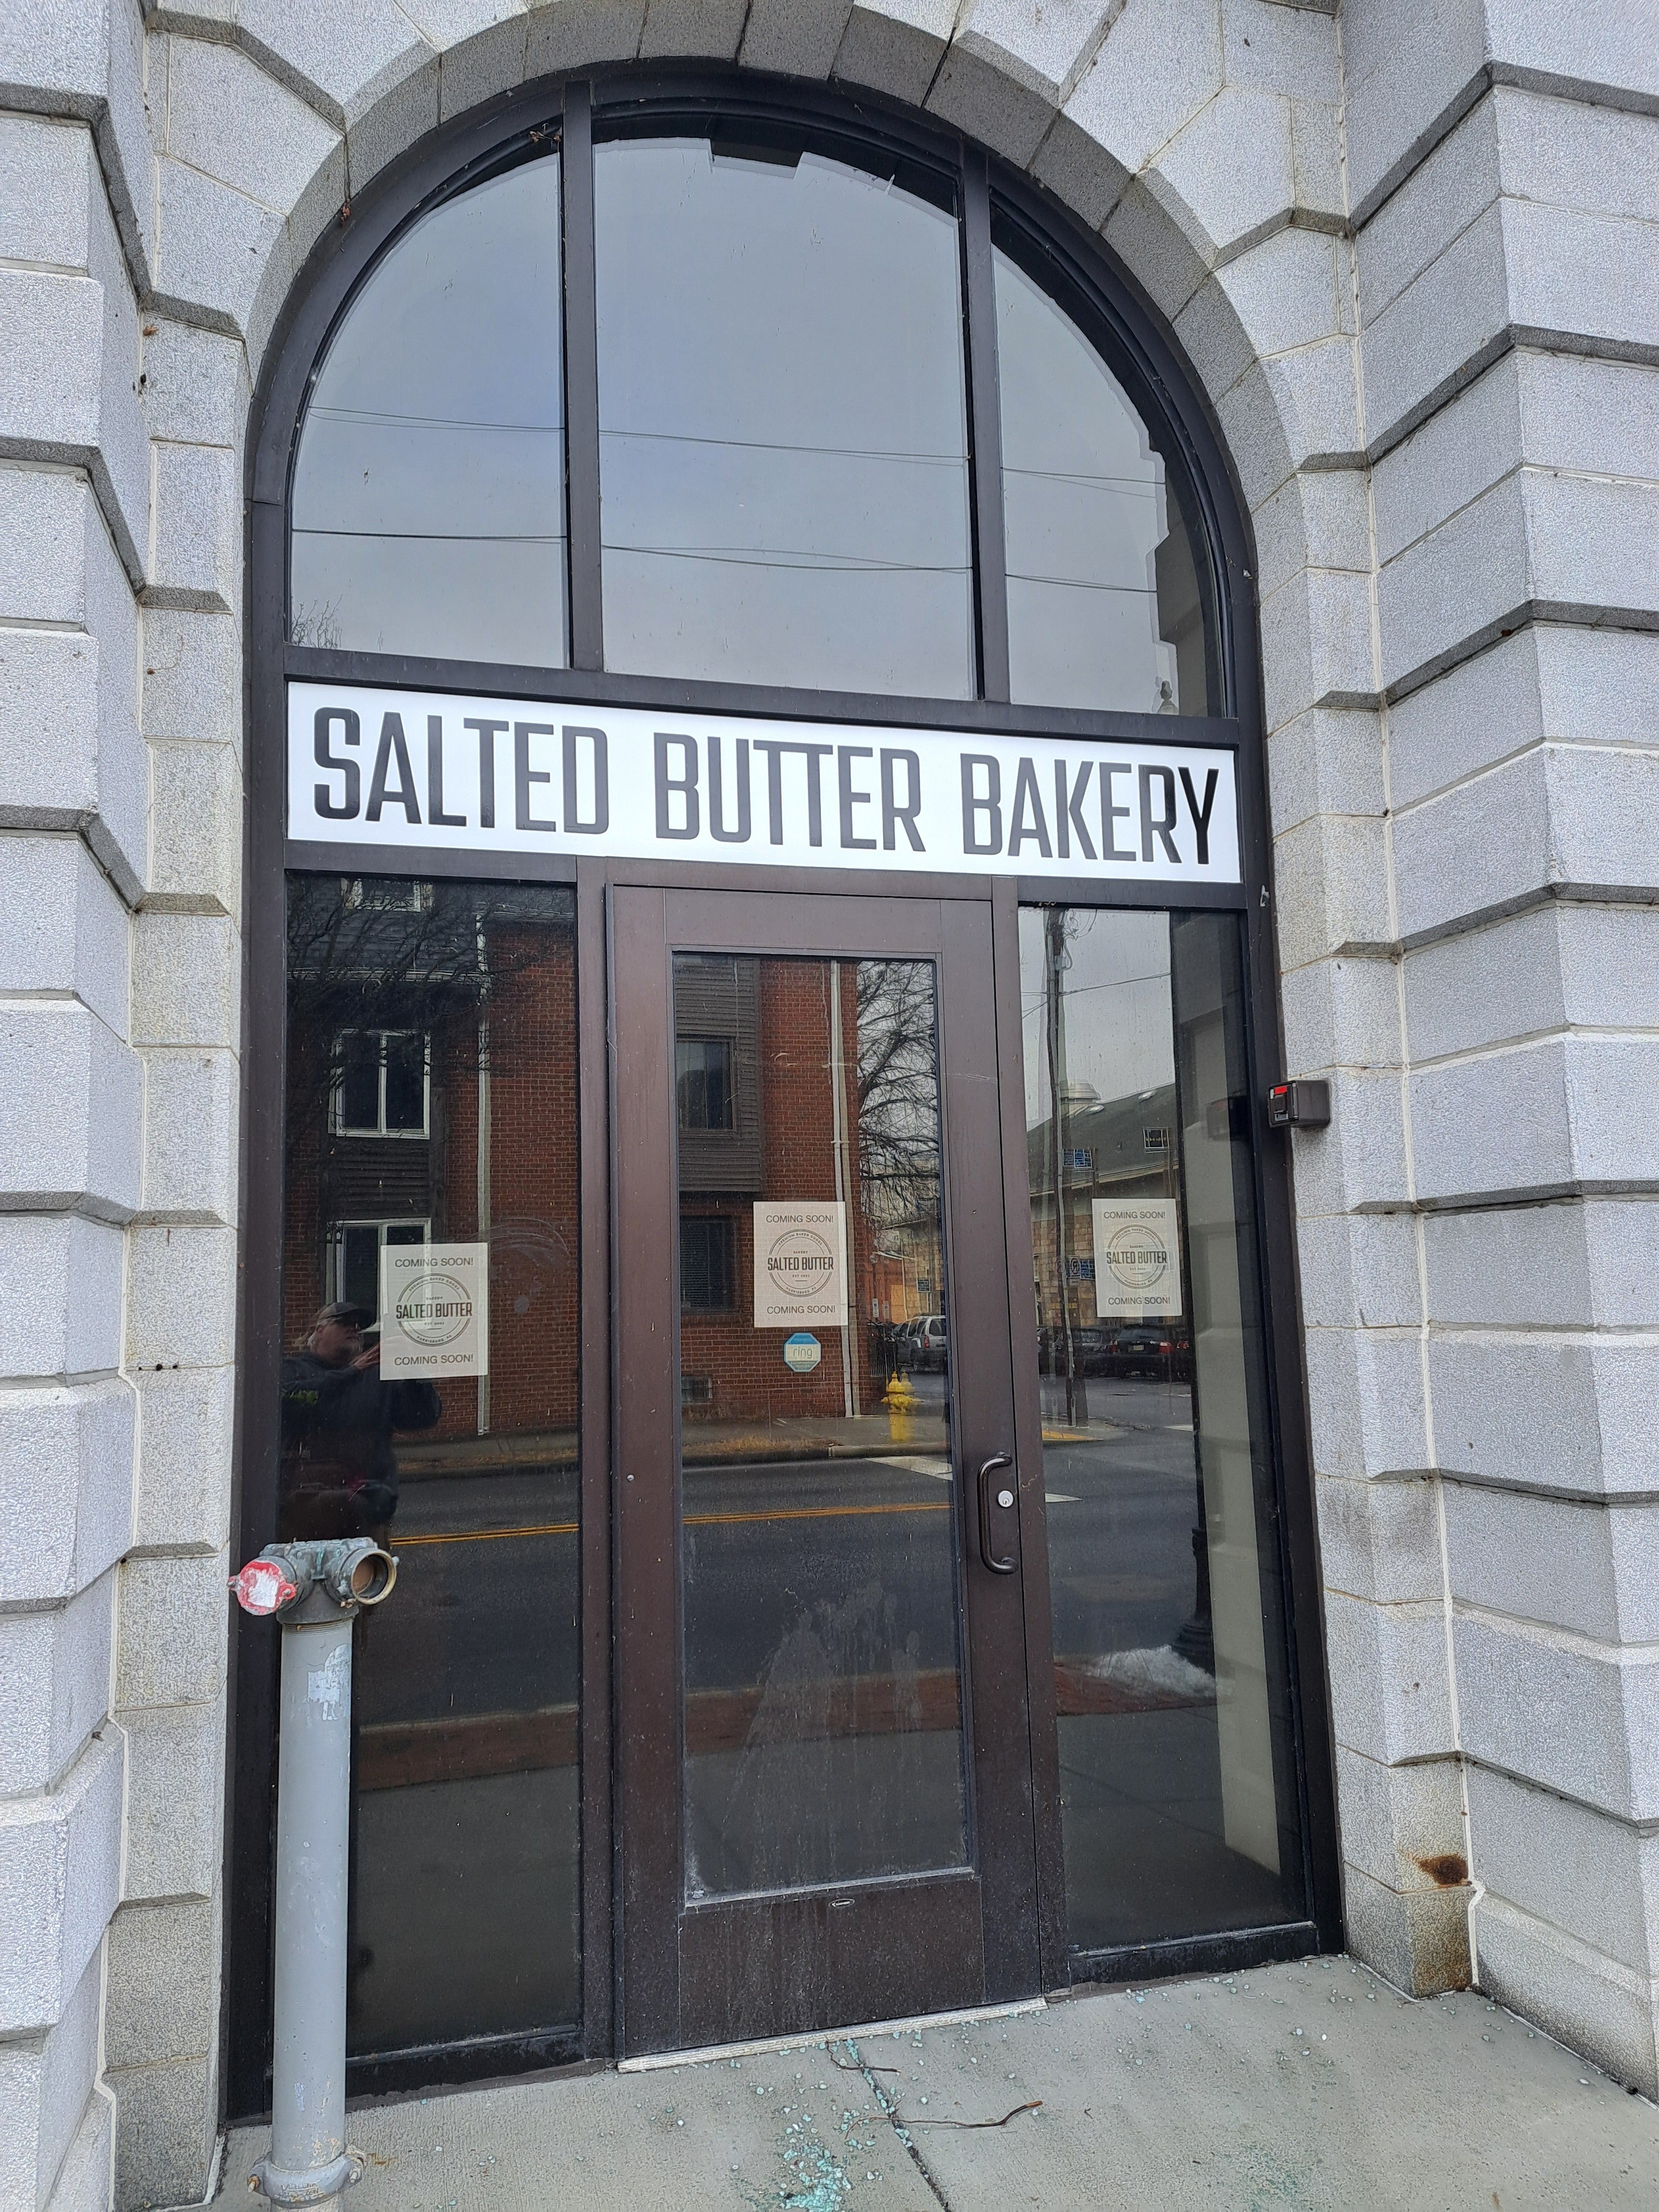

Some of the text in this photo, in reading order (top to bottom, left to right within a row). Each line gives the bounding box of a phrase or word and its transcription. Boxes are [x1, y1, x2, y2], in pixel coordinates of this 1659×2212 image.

[313, 706, 1220, 865] SALTED BUTTER BAKERY
[806, 1215, 834, 1223] SOON!
[395, 1257, 474, 1267] COMING SOON!
[1106, 1251, 1167, 1264] SALTED BUTTER
[767, 1257, 834, 1271] SALTED BUTTER
[396, 1302, 473, 1319] SALTED BUTTER
[767, 1305, 836, 1314] COMING SOON!
[793, 1347, 812, 1359] ring
[394, 1354, 473, 1365] COMING SOON!
